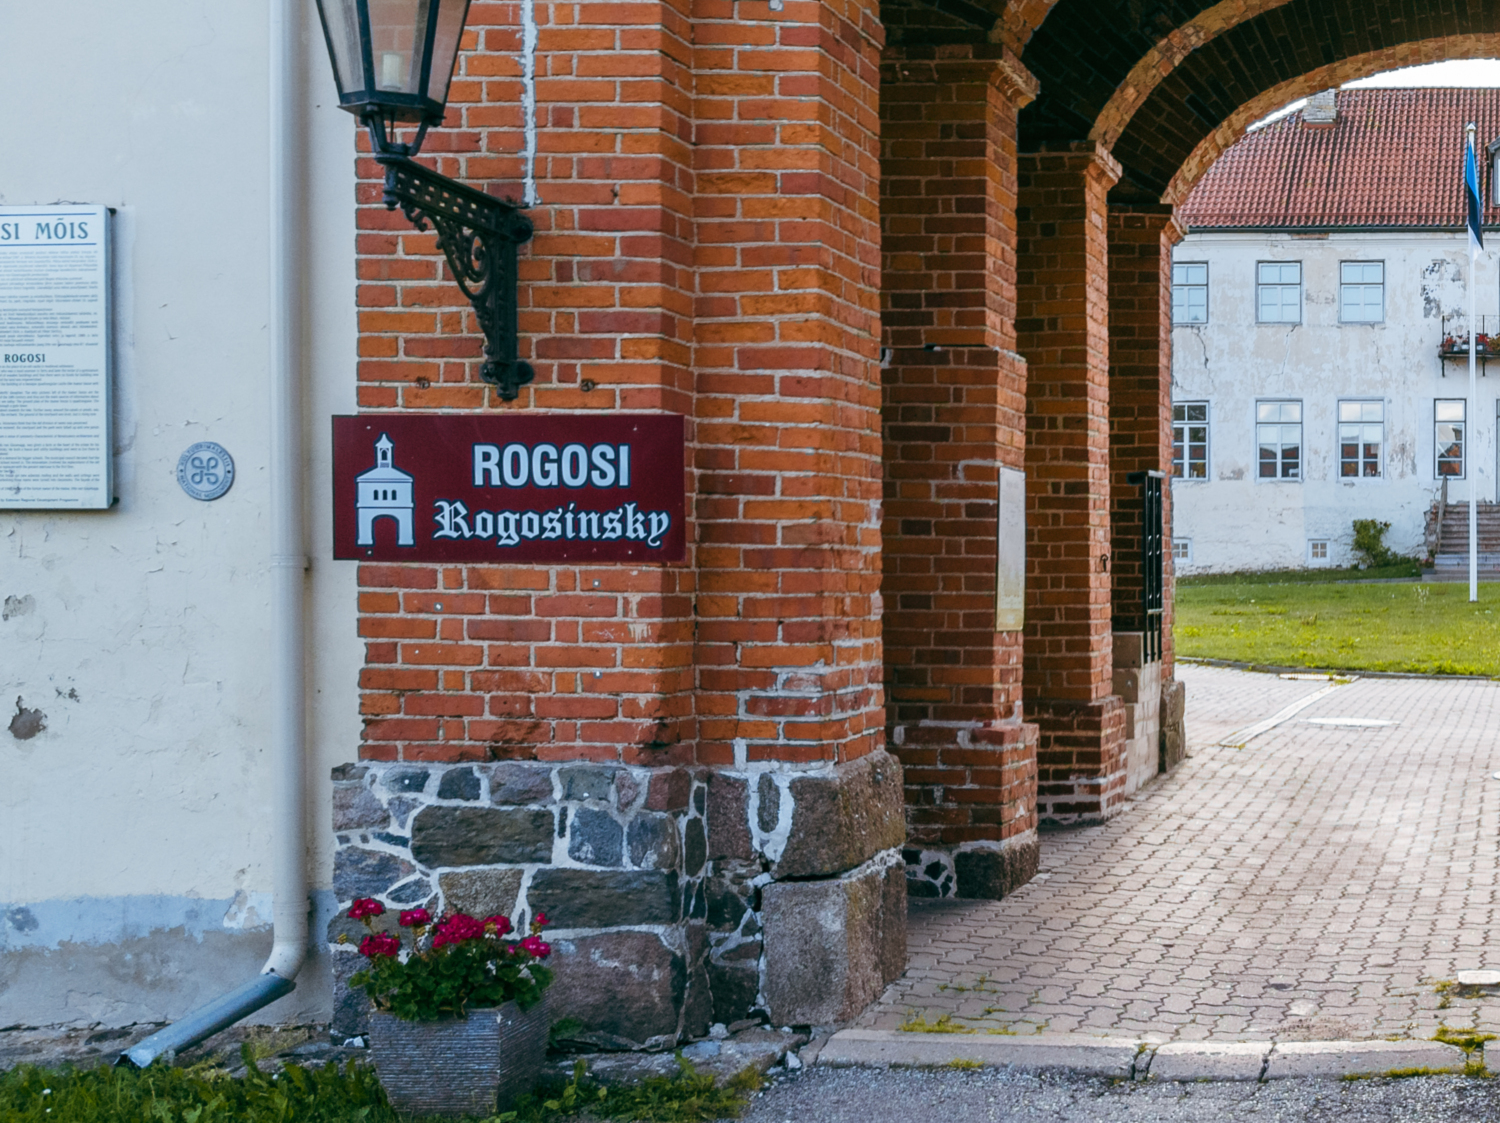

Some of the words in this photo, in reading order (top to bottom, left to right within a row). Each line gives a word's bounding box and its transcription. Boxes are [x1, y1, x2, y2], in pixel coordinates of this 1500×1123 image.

[35, 217, 89, 240] MÕIS
[4, 353, 46, 363] ROGOSI
[473, 443, 630, 487] ROGOSI
[433, 500, 670, 547] Rogosinsky
